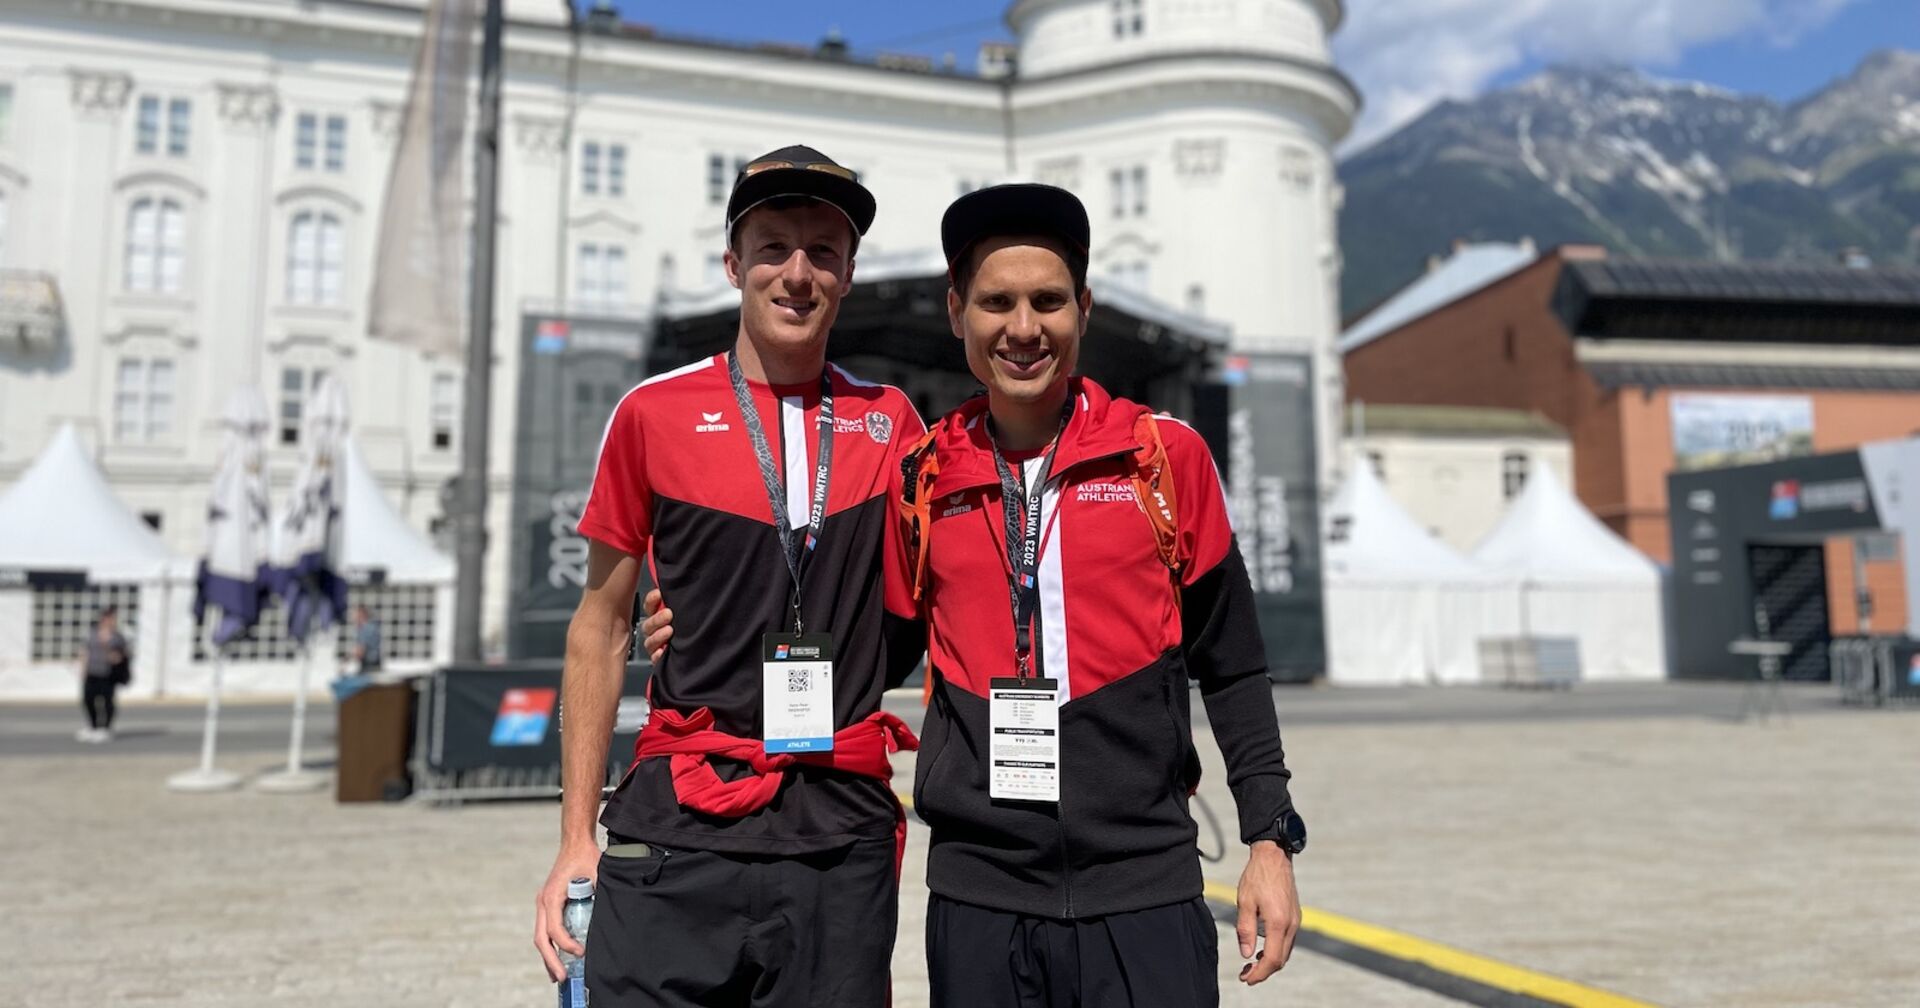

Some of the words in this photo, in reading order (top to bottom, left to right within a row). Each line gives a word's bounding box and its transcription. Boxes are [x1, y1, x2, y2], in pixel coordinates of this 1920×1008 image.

[815, 416, 863, 425] ATRIAN
[695, 423, 730, 433] erima
[814, 465, 828, 502] WMTRC
[1077, 482, 1132, 493] AUSTRIAN
[1077, 492, 1134, 502] ATHLETICS
[810, 503, 823, 530] 2023
[942, 504, 972, 517] erima
[1026, 496, 1040, 537] WMTRC
[1023, 540, 1036, 566] 2023
